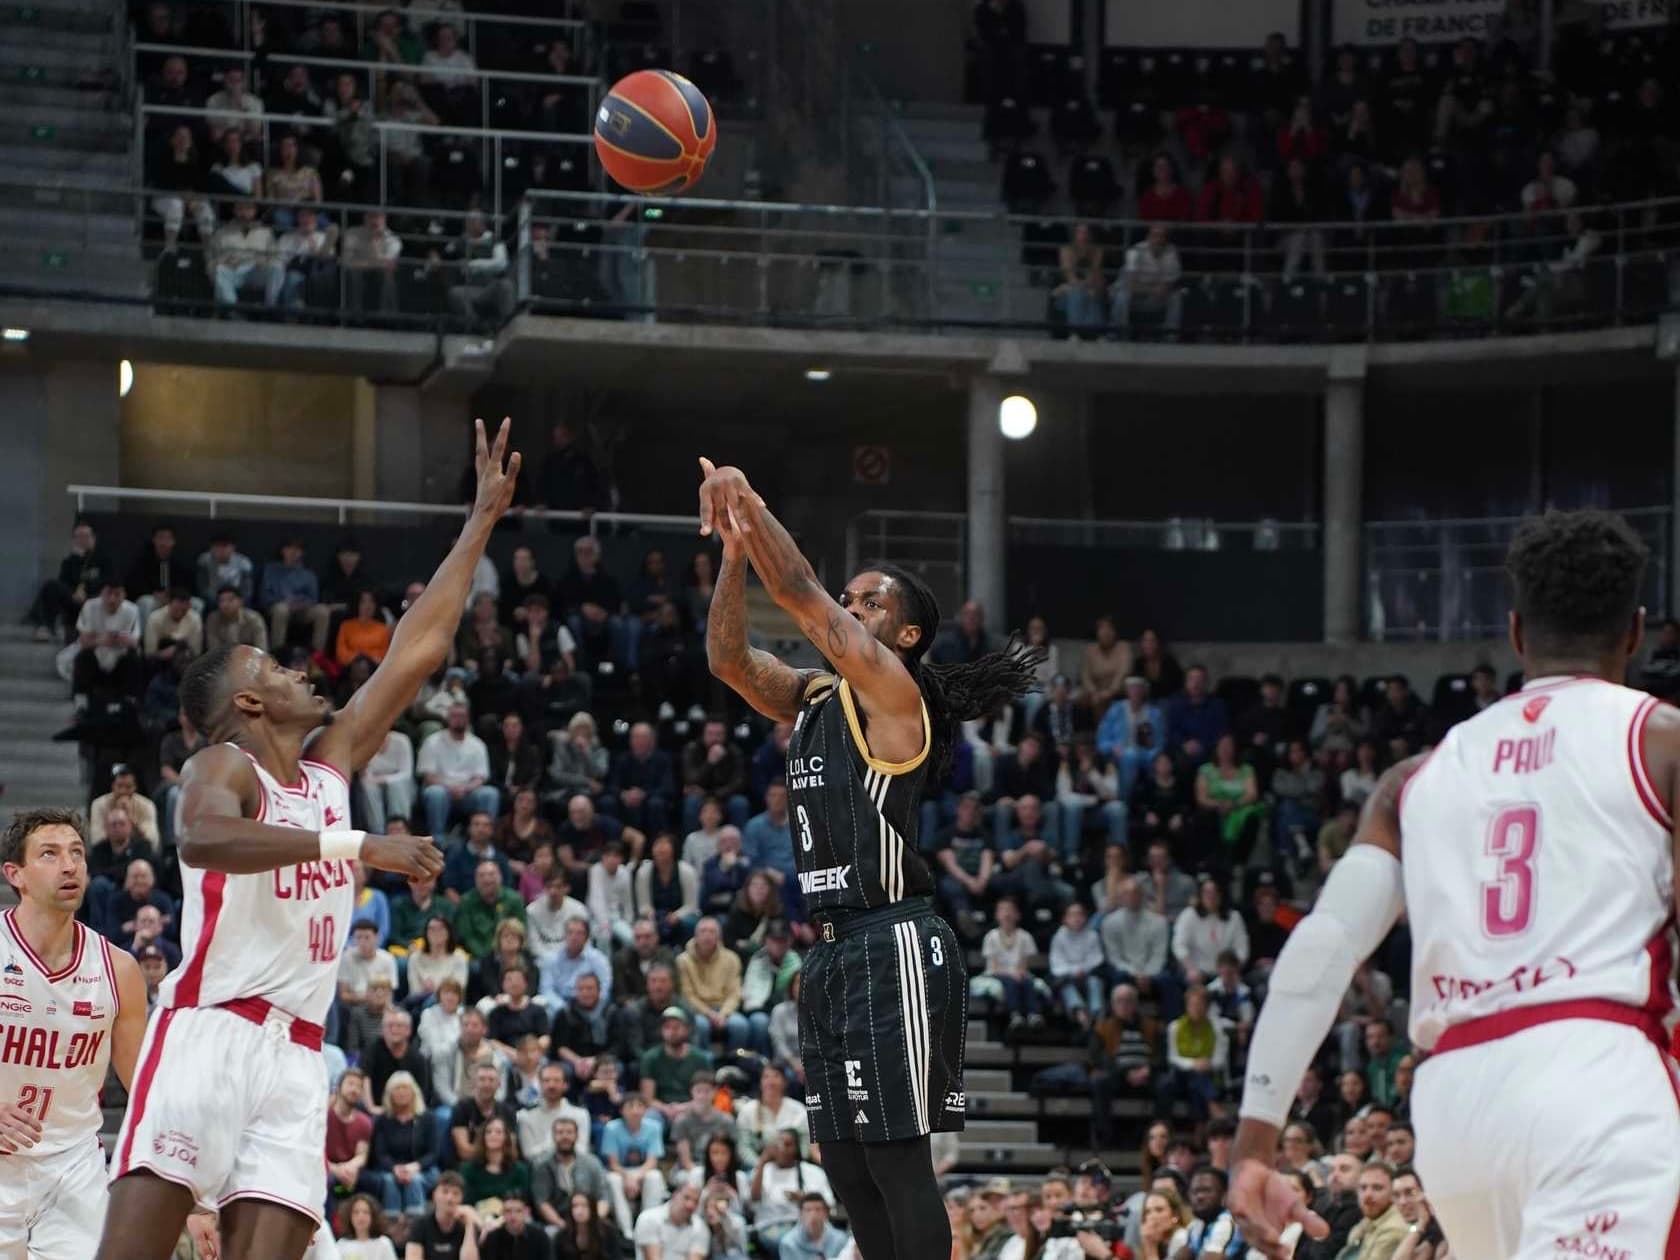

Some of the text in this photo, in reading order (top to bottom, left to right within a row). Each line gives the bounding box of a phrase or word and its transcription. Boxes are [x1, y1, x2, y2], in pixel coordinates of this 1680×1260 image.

[1366, 17, 1395, 37] DE
[796, 804, 813, 852] 3
[1482, 803, 1543, 939] 3
[309, 915, 336, 963] 40
[930, 936, 944, 966] 3
[0, 1026, 104, 1070] HALON
[17, 1084, 54, 1121] 21
[167, 1146, 198, 1168] JOA
